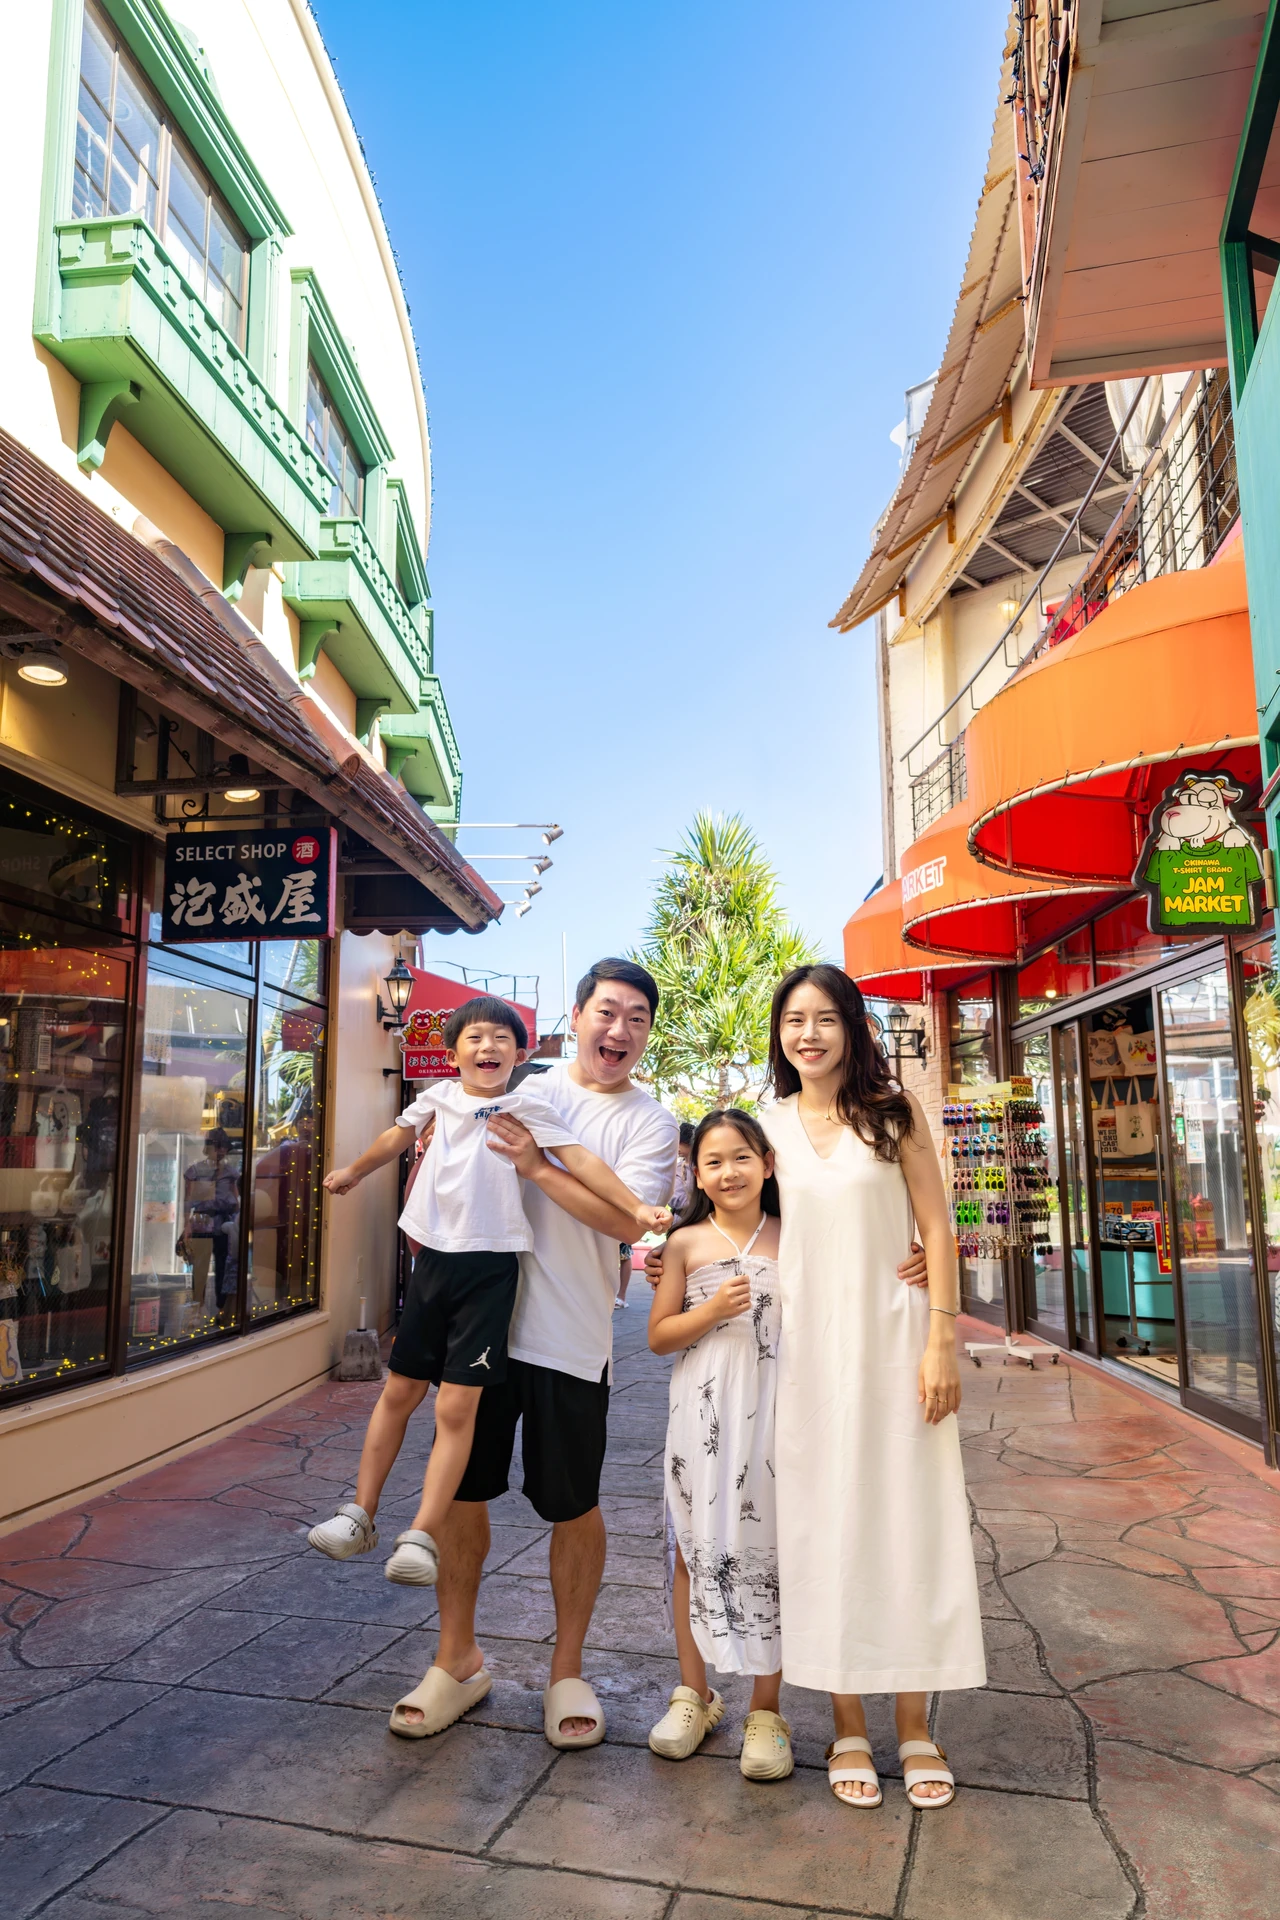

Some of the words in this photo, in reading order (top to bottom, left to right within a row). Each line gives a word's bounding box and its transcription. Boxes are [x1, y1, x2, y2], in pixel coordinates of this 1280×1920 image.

[175, 845, 236, 862] SELECT
[240, 843, 287, 859] SHOP
[296, 841, 316, 859] 酒
[1172, 867, 1203, 875] T-SHIRT
[1183, 859, 1221, 867] OKINAWA
[1182, 876, 1225, 894] JAM
[169, 869, 322, 927] 泡盛屋
[1164, 895, 1245, 913] MARKET
[1110, 1207, 1123, 1215] 70
